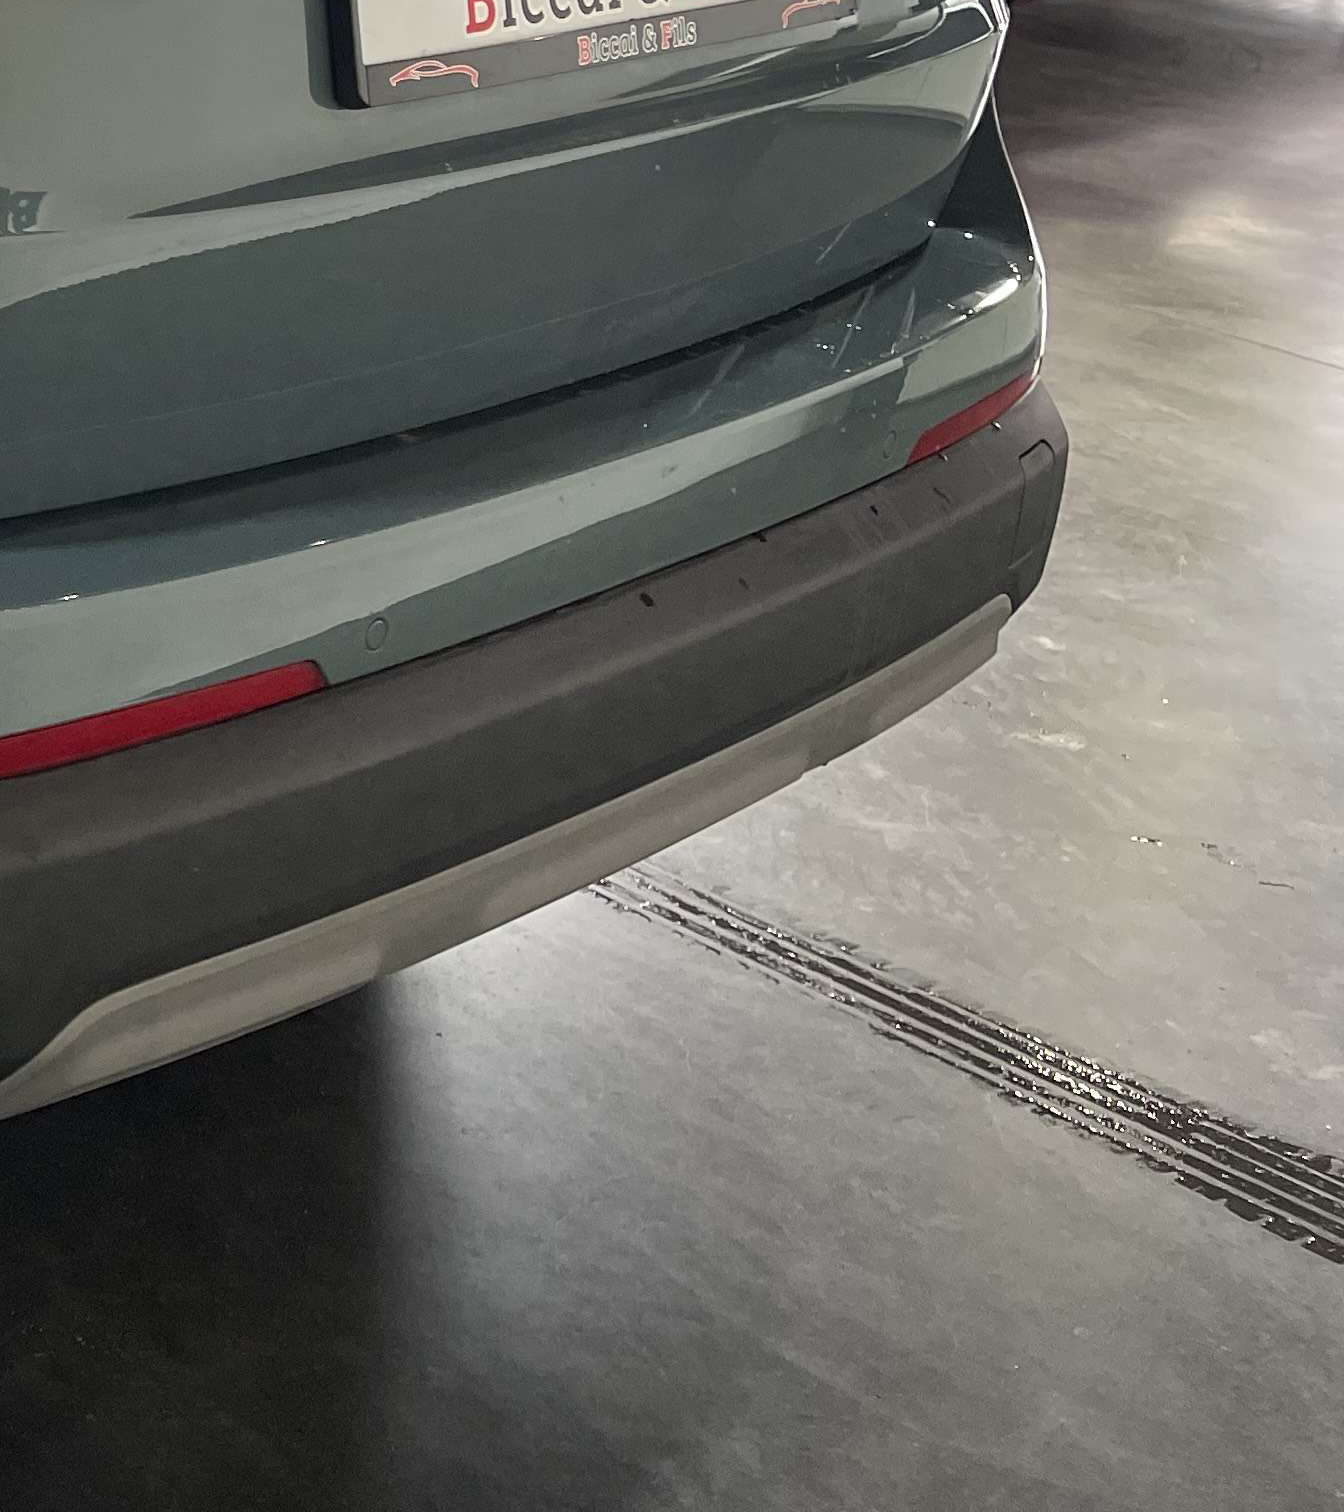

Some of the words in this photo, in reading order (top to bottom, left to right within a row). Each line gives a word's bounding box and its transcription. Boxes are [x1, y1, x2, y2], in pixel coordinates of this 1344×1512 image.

[577, 28, 640, 67] Biccai
[642, 21, 659, 54] &
[660, 15, 698, 51] Fils
